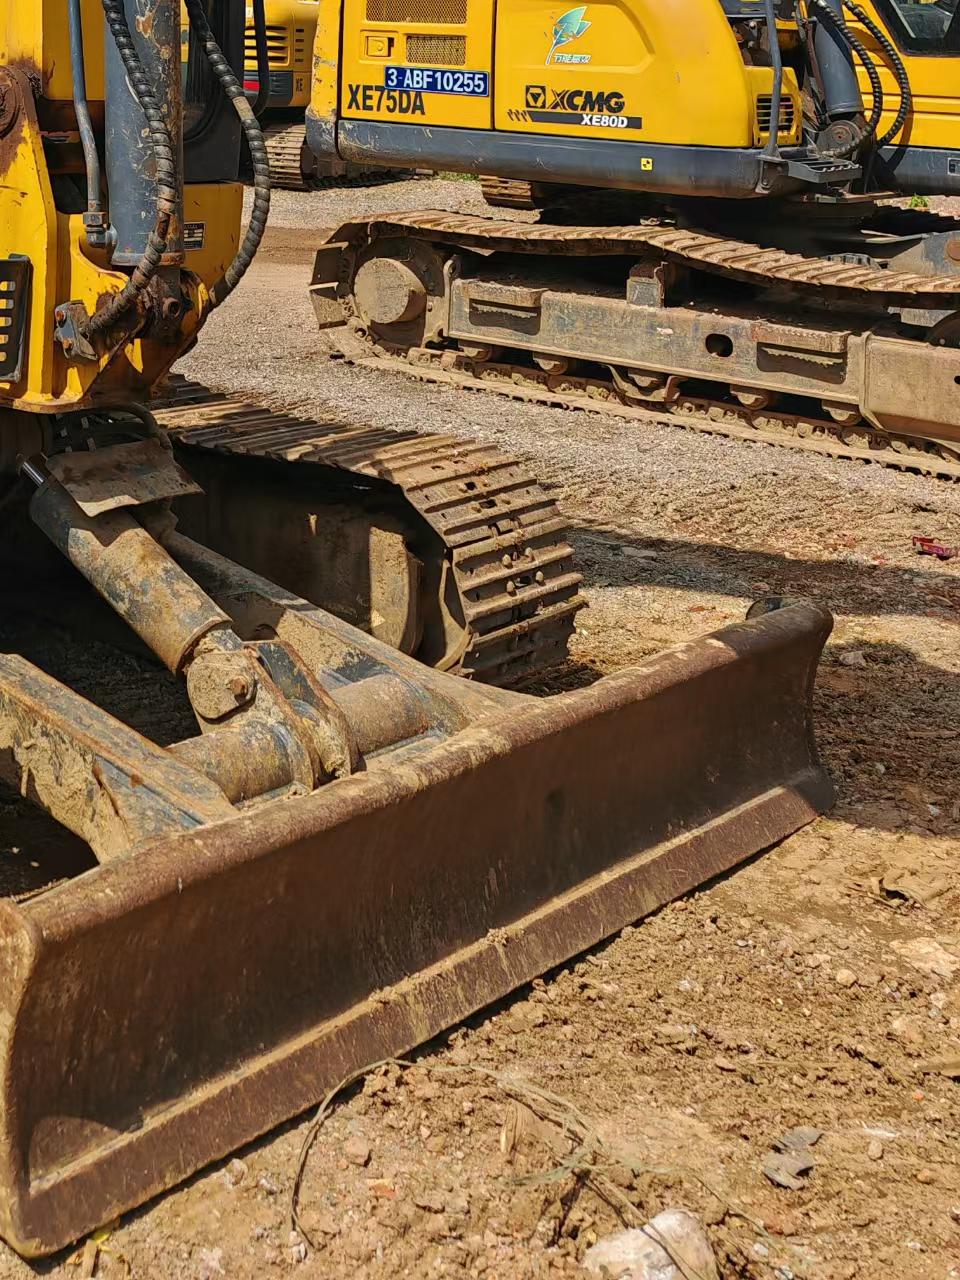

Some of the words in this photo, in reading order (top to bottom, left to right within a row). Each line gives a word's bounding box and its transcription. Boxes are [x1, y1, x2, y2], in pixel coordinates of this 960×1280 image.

[347, 84, 426, 115] XE75DA
[547, 88, 625, 114] XCMG
[581, 113, 628, 128] XE80D
